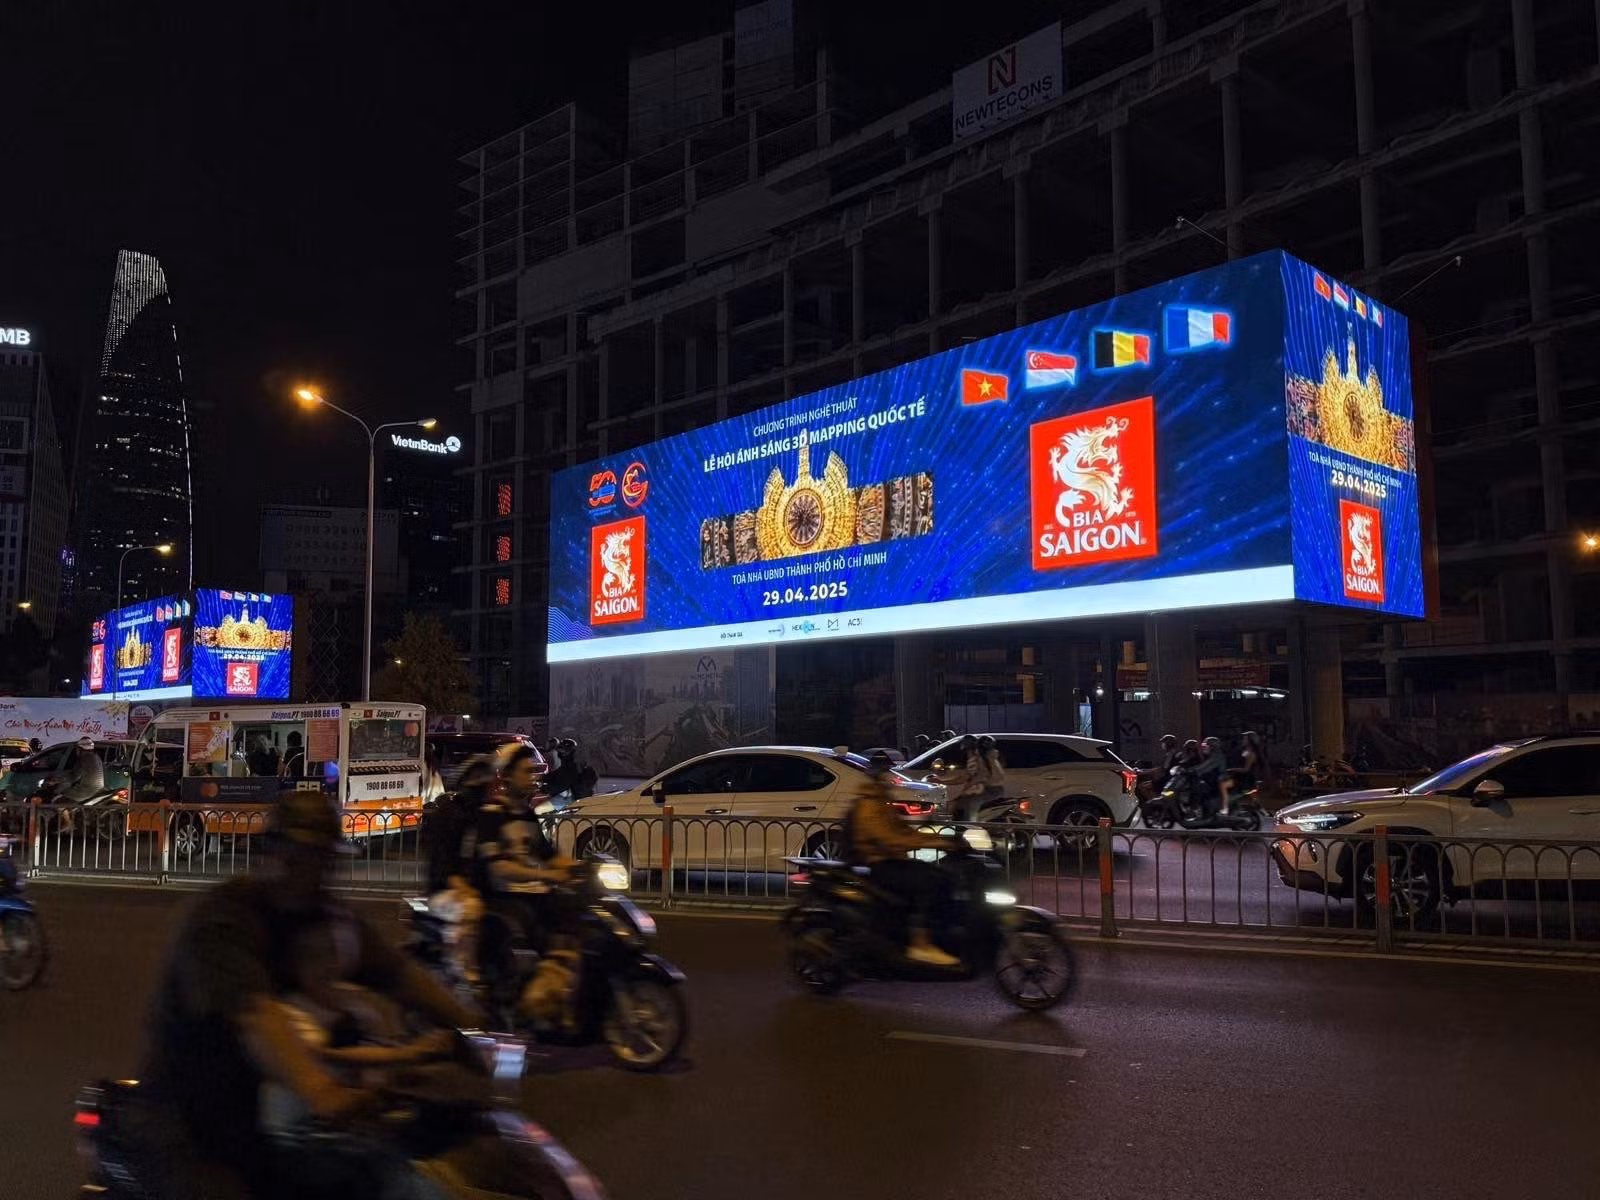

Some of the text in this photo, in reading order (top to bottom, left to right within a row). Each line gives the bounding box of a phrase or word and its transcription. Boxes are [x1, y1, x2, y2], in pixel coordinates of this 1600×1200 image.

[955, 75, 1053, 130] NEWTECONS
[0, 327, 31, 345] MB
[753, 396, 858, 437] CHƯƠNG TRÌNH NGHỆ THUẬT
[391, 434, 448, 454] VietinBank
[704, 453, 717, 473] LỄ
[717, 450, 735, 471] HỘI
[736, 446, 760, 465] ÁNH
[760, 438, 791, 458] SÁNG
[809, 416, 866, 446] MAPPING
[867, 403, 906, 431] QUỐC
[907, 395, 926, 419] TẾ
[1331, 469, 1387, 498] 29.04.2025
[1073, 509, 1105, 528] BIA
[1039, 520, 1141, 558] SAIGON
[732, 551, 887, 585] TOÀ NHÀ UBND THÀNH PHỐ HỒ CHÍ MINH
[609, 587, 623, 599] BIA
[762, 580, 848, 606] 29.04.2025
[1346, 573, 1380, 594] SAIGON
[594, 597, 638, 617] SAIGON
[366, 781, 379, 791] 1900
